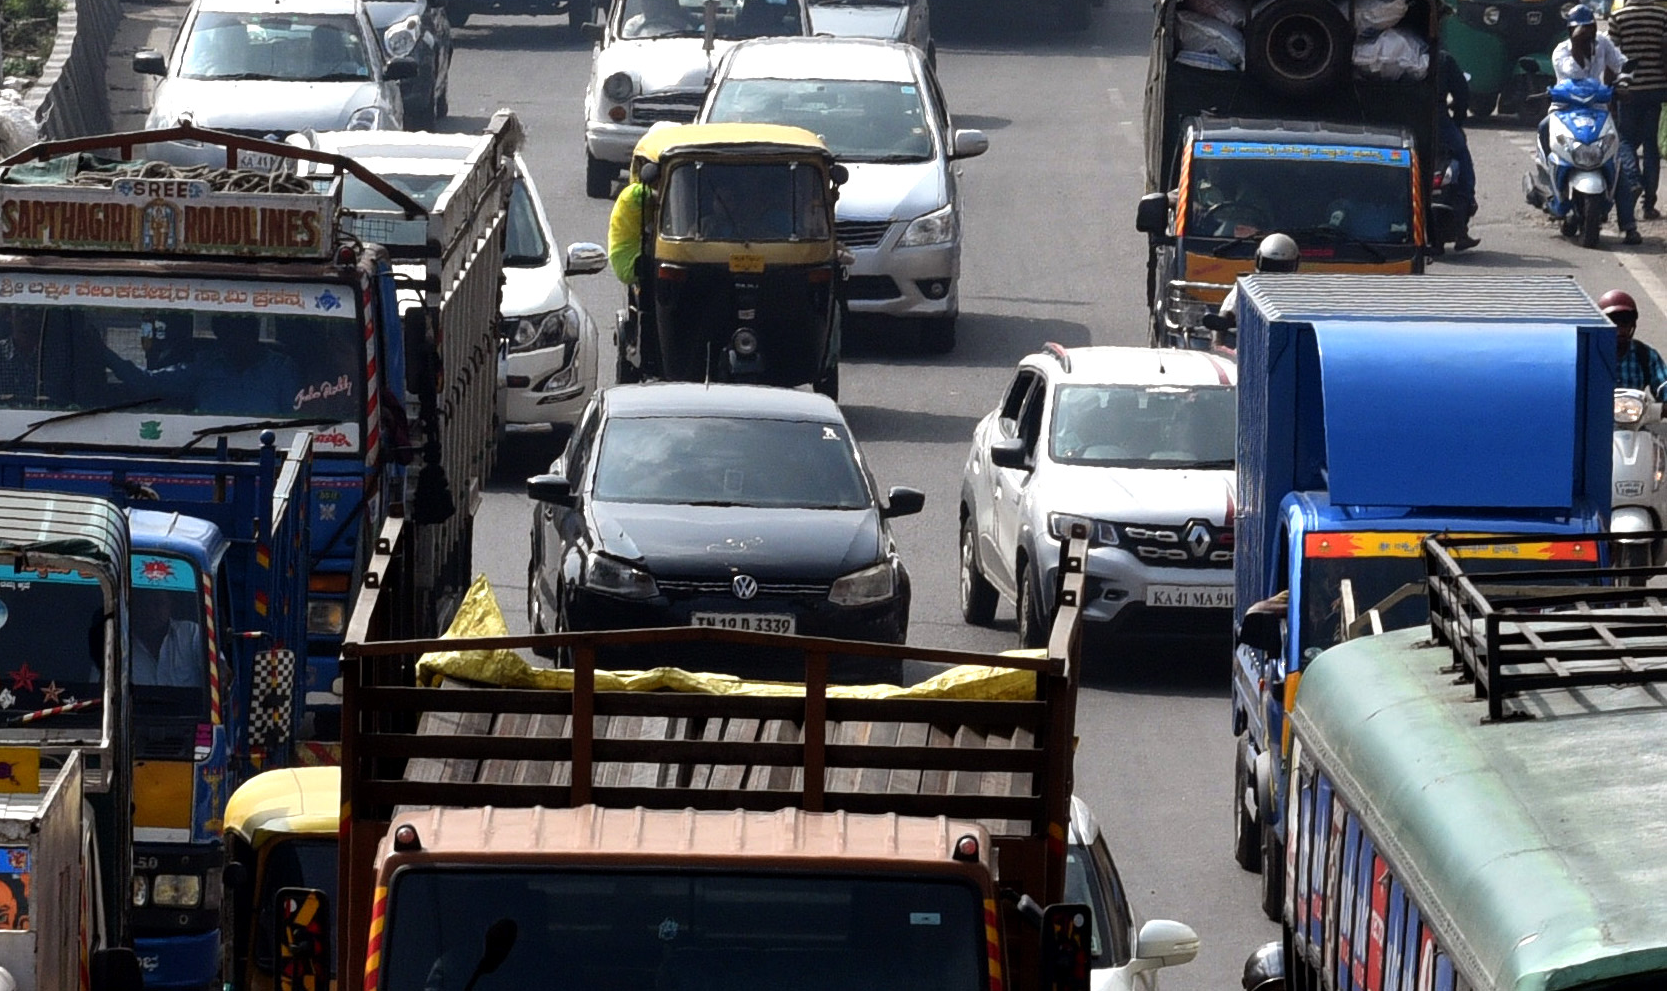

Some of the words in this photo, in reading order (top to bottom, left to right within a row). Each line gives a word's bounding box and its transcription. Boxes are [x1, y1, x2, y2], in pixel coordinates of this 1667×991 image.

[133, 182, 188, 198] SREE
[2, 200, 134, 244] SAPTHAGIRI
[185, 205, 320, 249] ROADLINES
[1153, 591, 1173, 605] KA
[1175, 592, 1188, 605] 41
[1193, 592, 1213, 606] MA
[754, 617, 791, 634] 3339
